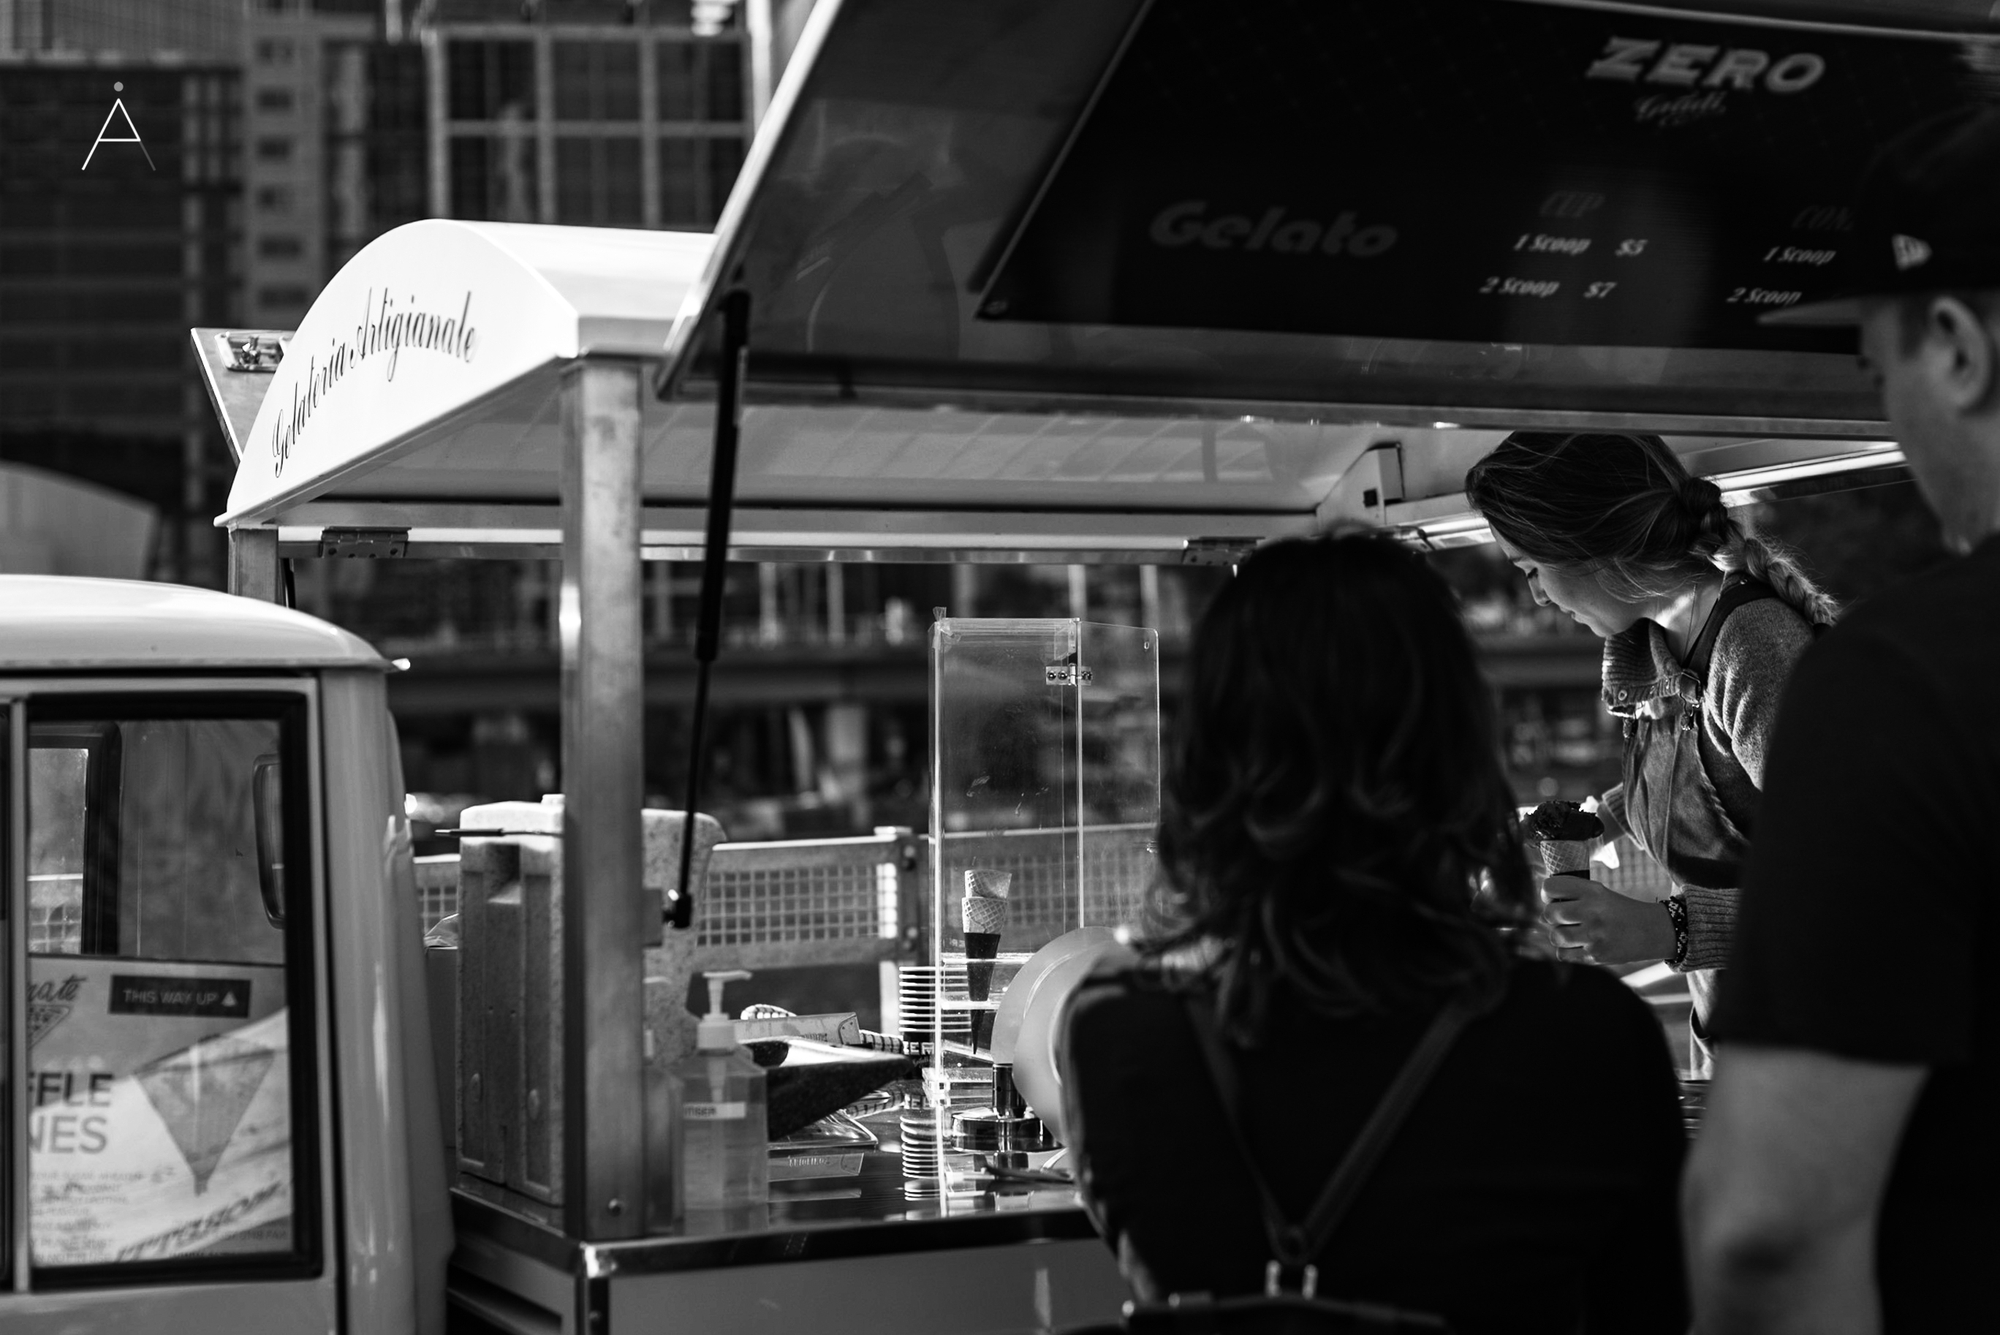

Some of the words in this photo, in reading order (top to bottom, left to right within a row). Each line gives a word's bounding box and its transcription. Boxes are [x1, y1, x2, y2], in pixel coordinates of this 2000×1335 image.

[1584, 34, 1827, 94] ZERO
[1149, 200, 1399, 258] Gelato
[1513, 233, 1530, 252] 1
[1528, 233, 1592, 257] Scoop
[1762, 245, 1781, 263] 1
[1777, 245, 1837, 267] Scoop
[1478, 276, 1500, 294] 2
[1498, 277, 1561, 299] Scoop
[1726, 286, 1748, 303] 2
[272, 337, 347, 478] Gelateria
[350, 287, 476, 382] Artigianale
[123, 989, 157, 1004] THIS
[160, 990, 193, 1005] WAY
[196, 992, 218, 1006] UP
[30, 1071, 114, 1108] FLE
